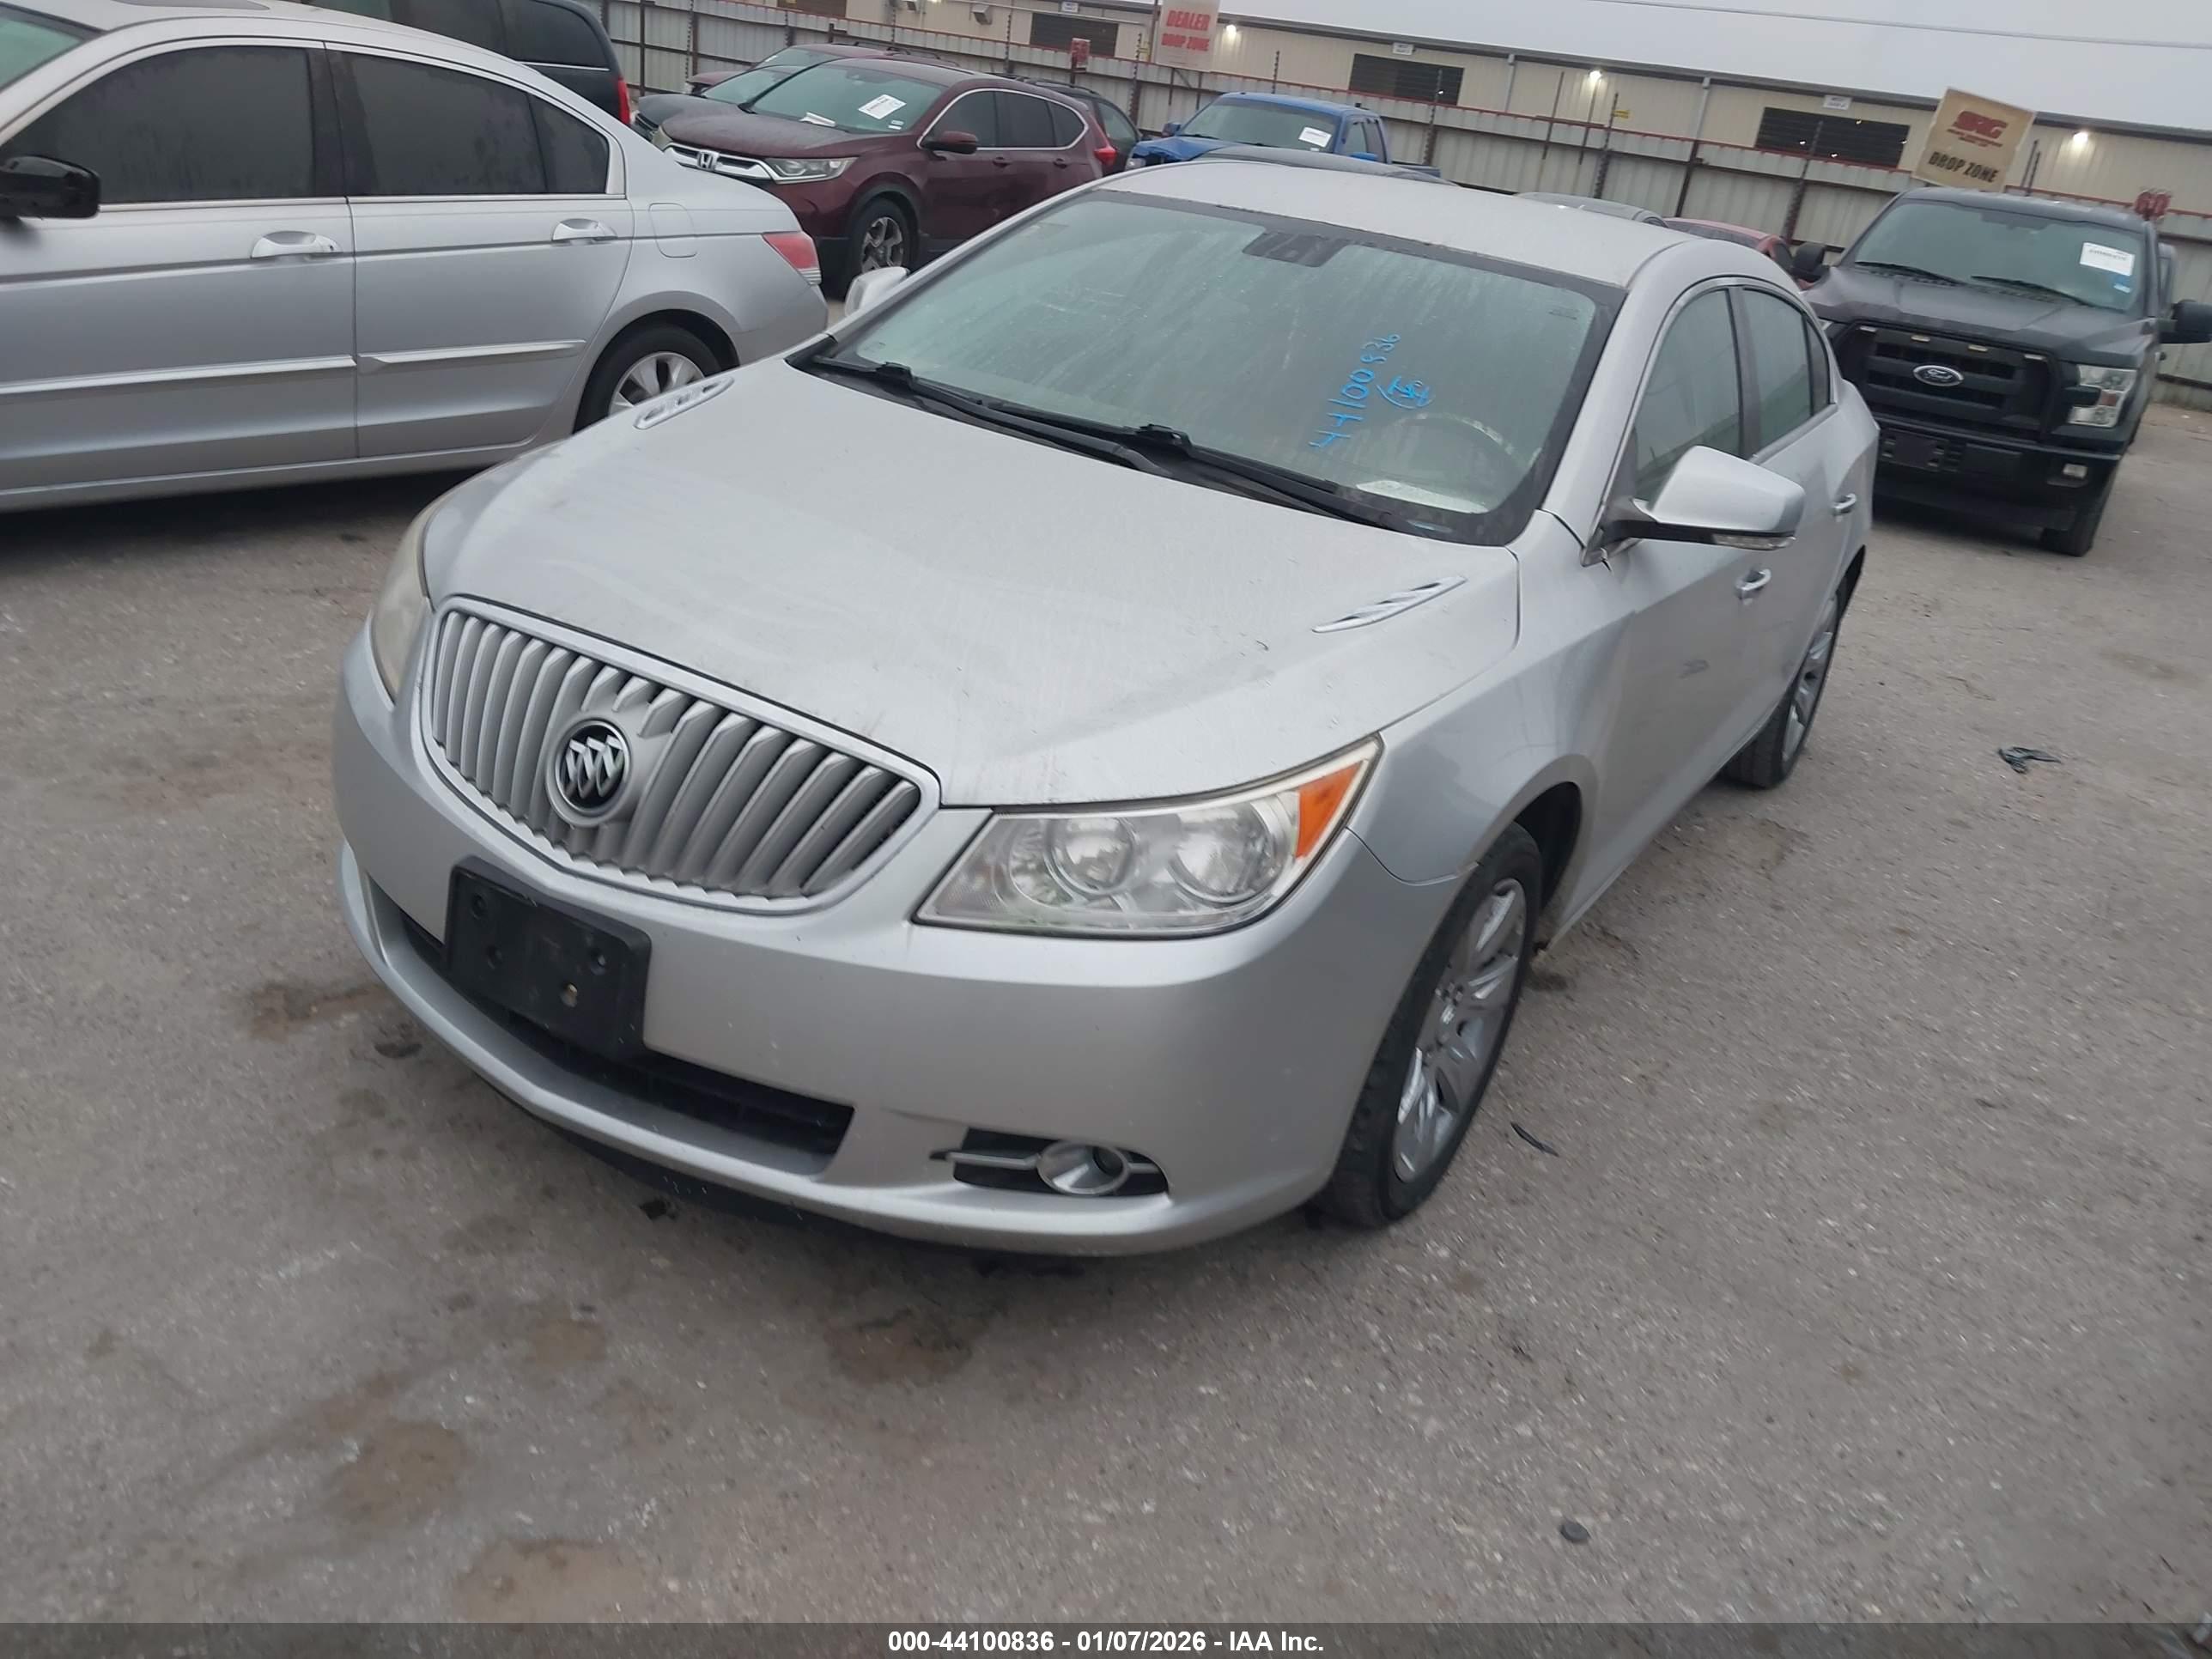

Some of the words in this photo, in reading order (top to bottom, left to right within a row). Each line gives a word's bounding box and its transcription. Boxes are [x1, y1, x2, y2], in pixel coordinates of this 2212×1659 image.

[1166, 9, 1210, 31] DEALER
[1161, 33, 1186, 47] DROP
[1187, 35, 1210, 52] ZONE
[1928, 150, 1965, 173] DROP
[1963, 161, 2000, 183] ZONE
[1307, 333, 1401, 448] 44100836
